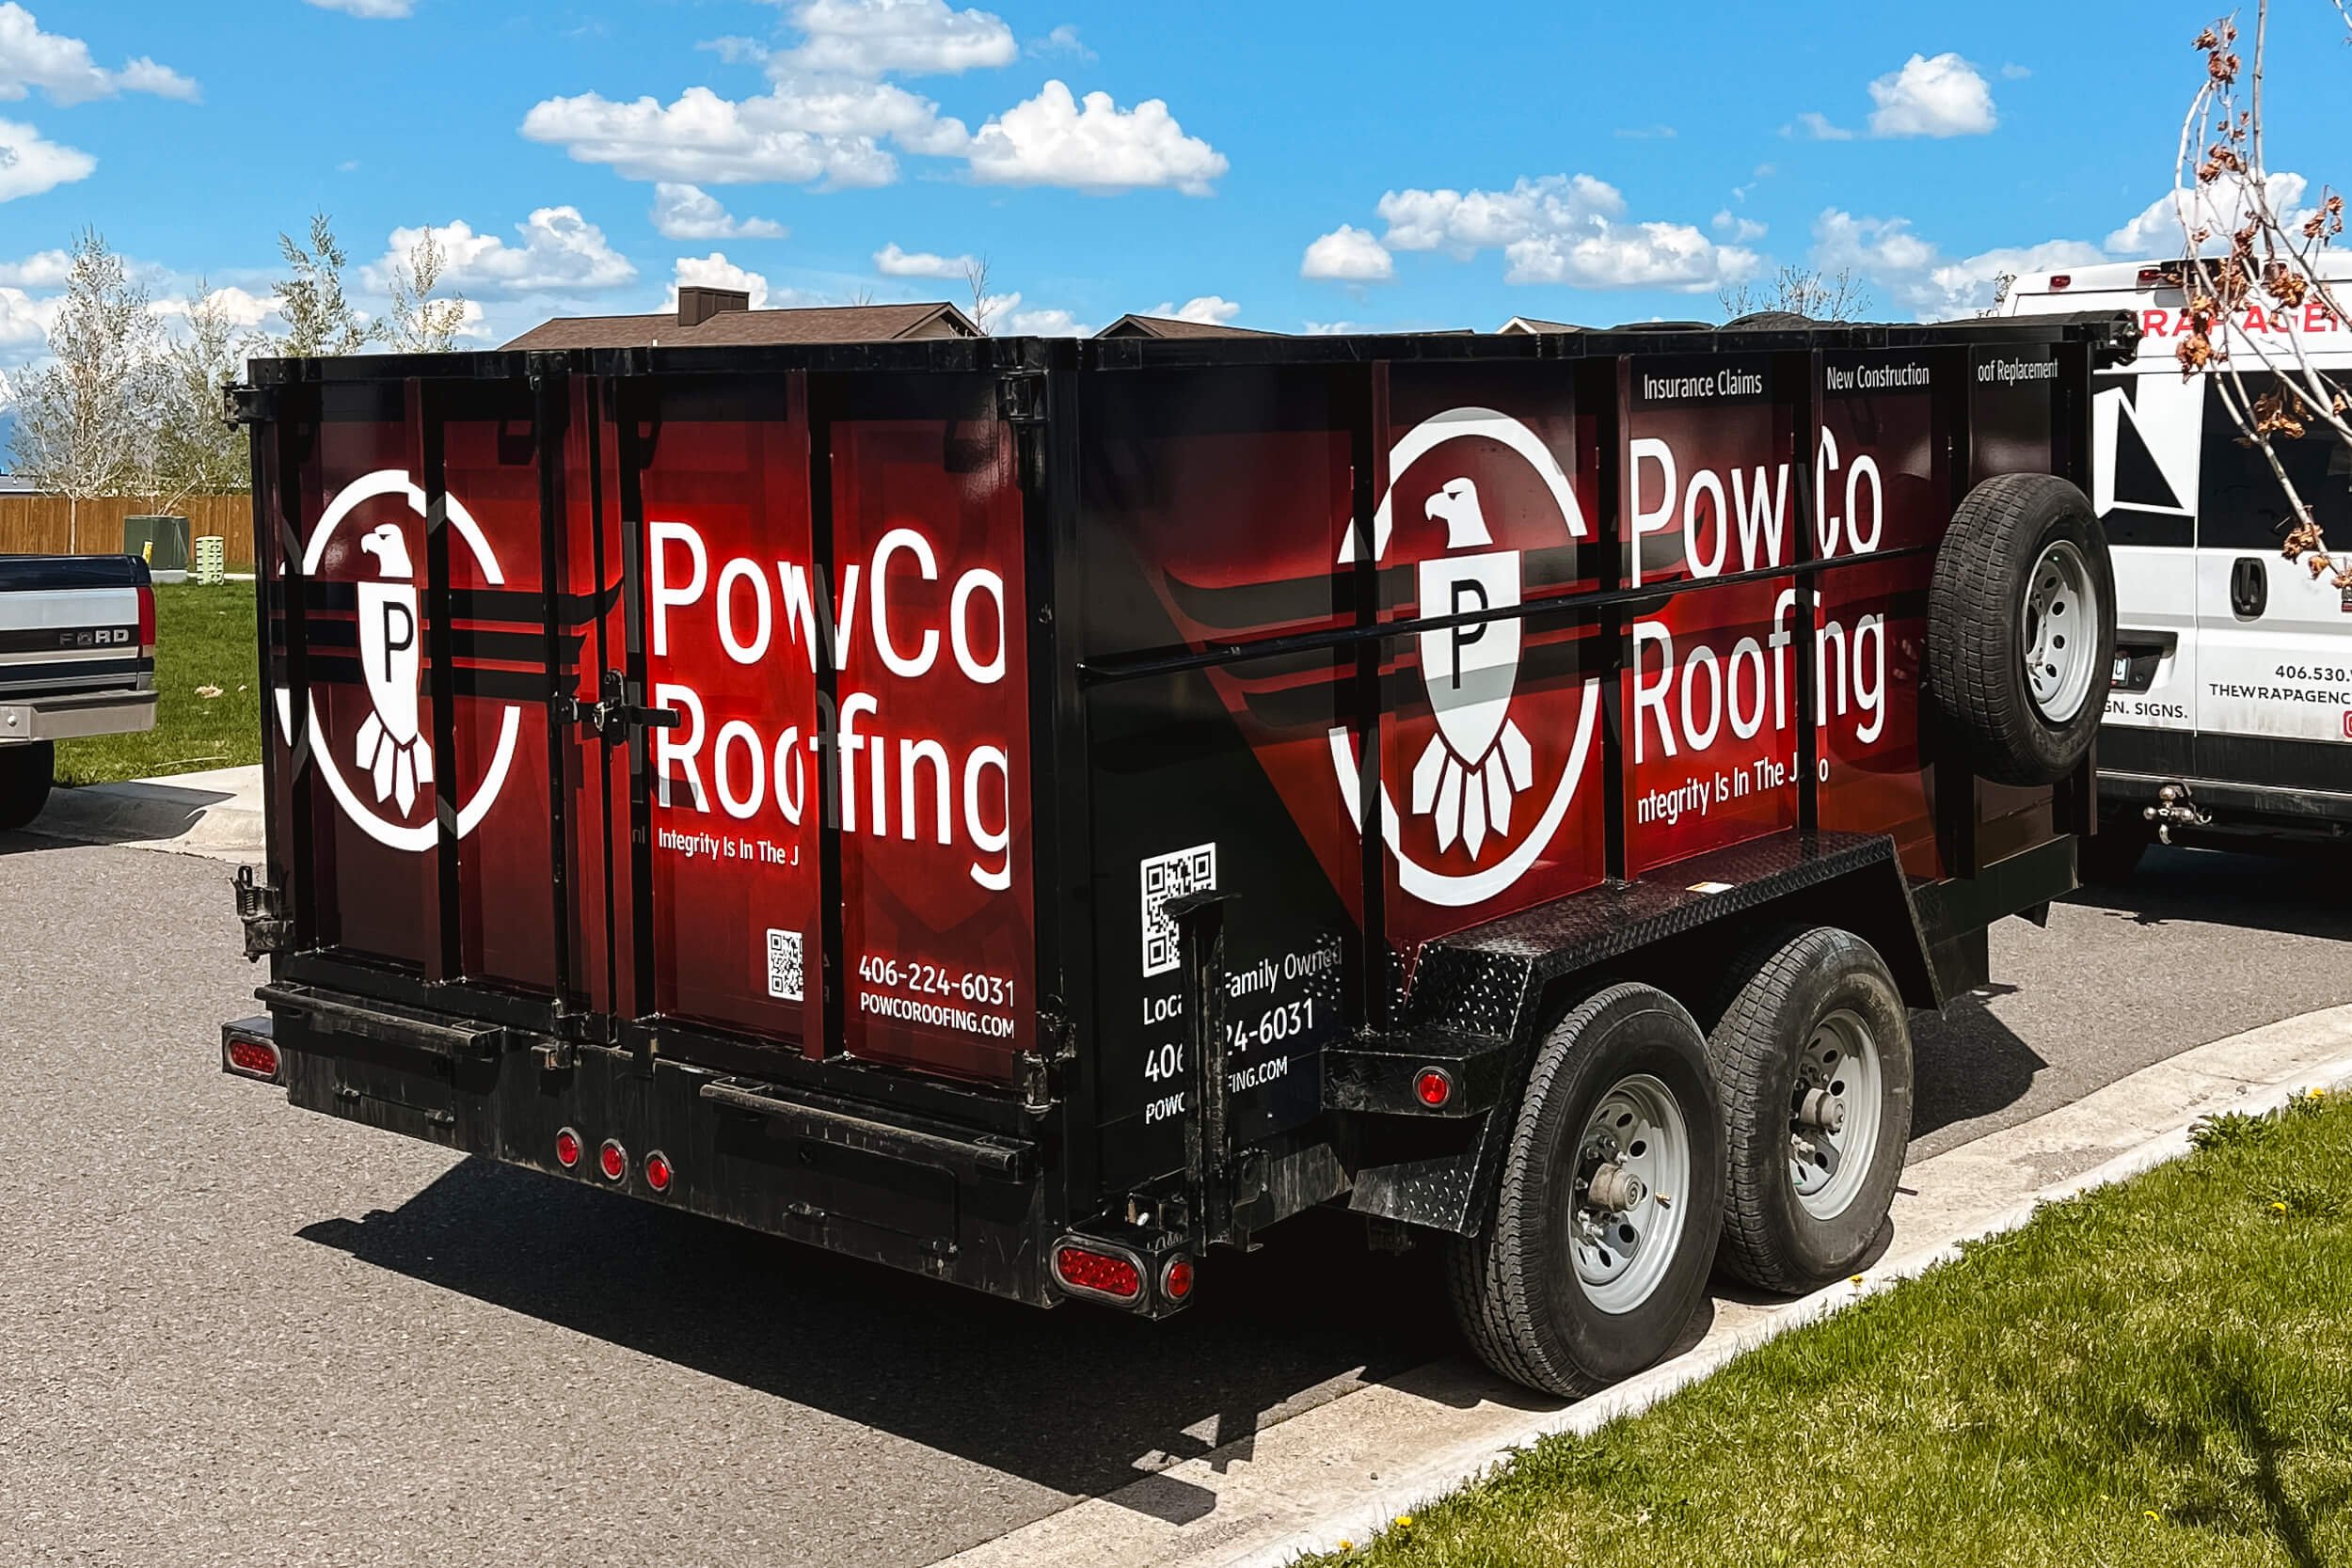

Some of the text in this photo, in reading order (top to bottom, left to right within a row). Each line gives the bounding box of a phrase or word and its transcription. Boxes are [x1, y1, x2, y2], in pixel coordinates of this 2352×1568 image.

[1644, 369, 1763, 400] Insurance Claims
[1826, 361, 1930, 390] New Construction
[1997, 356, 2058, 388] Replacement
[1629, 424, 1883, 589] PowCo
[649, 521, 1006, 684] PowCo
[59, 628, 129, 647] FORD
[383, 600, 414, 683] P
[1451, 578, 1489, 689] P
[1632, 588, 1885, 765] Roofing
[2275, 664, 2352, 682] 406.530.
[2135, 702, 2188, 719] SIGNS.
[655, 683, 1011, 891] Roofing
[1715, 771, 1729, 802] Is
[1734, 767, 1749, 798] In
[1753, 756, 1785, 791] The
[659, 827, 720, 861] Integrity
[723, 836, 736, 858] Is
[739, 838, 754, 860] In
[756, 840, 787, 865] The
[858, 955, 1015, 1007] 406-224-6031
[860, 991, 1015, 1039] POWCOROOFING.COM
